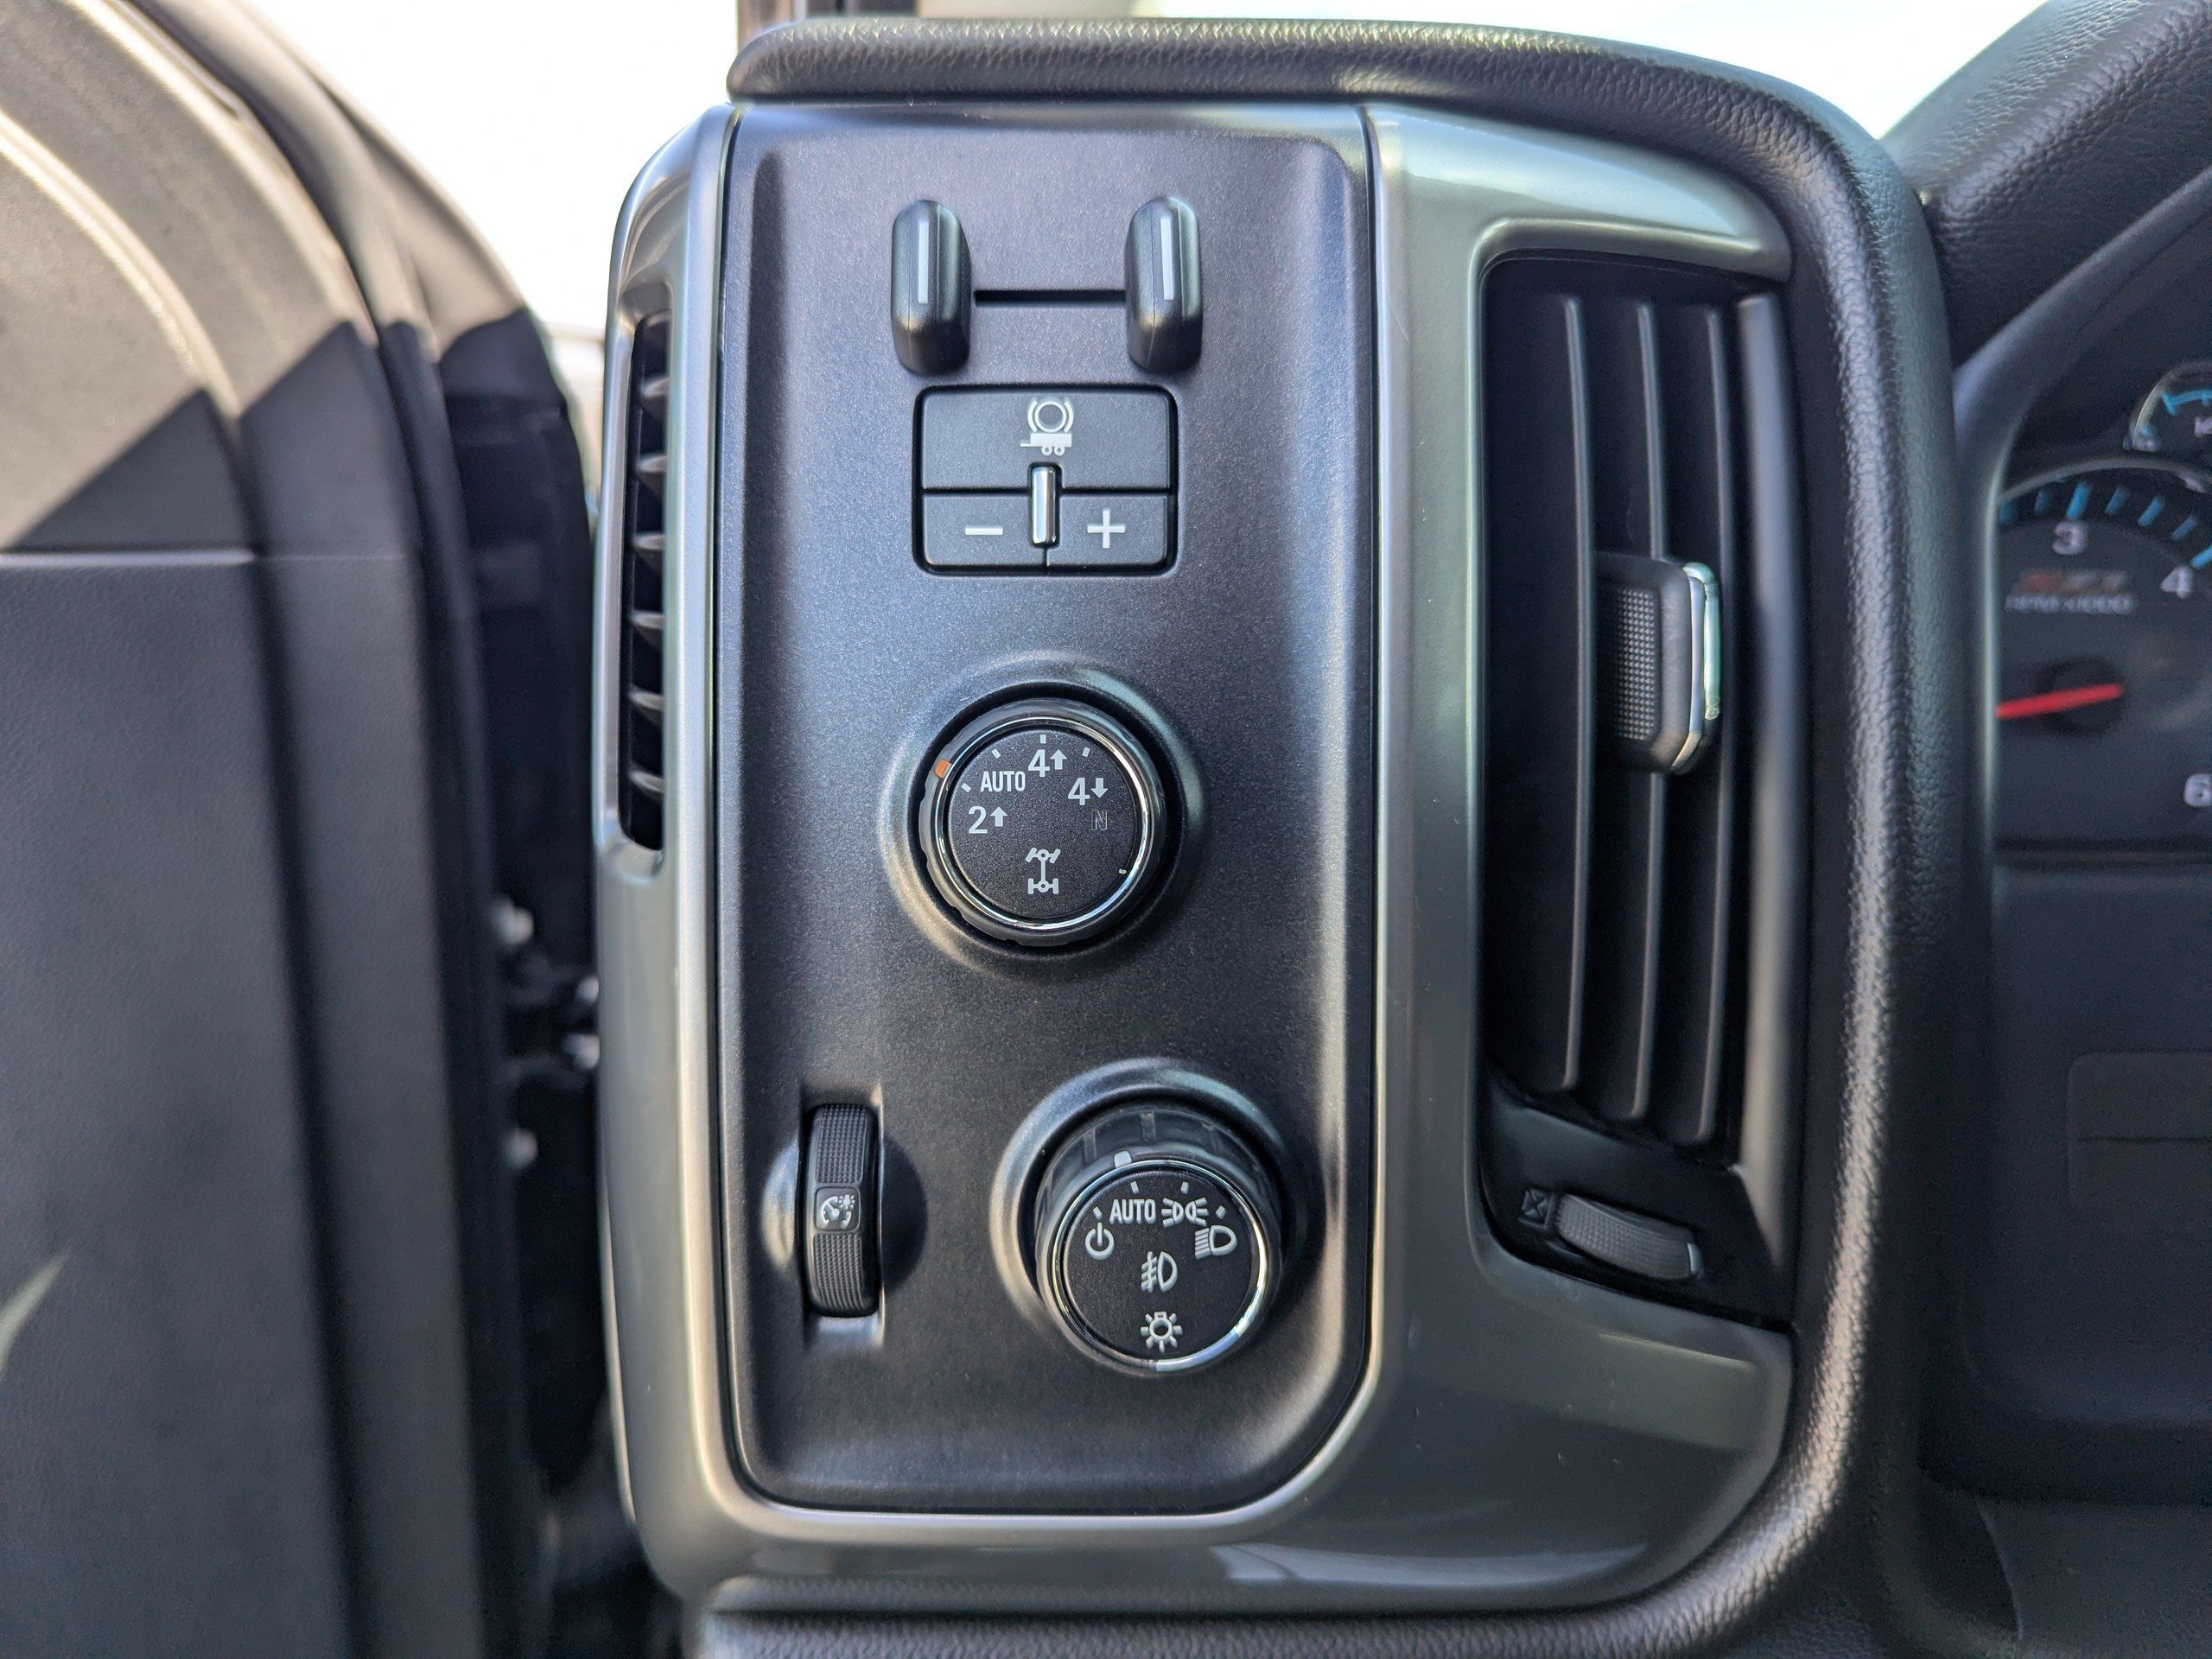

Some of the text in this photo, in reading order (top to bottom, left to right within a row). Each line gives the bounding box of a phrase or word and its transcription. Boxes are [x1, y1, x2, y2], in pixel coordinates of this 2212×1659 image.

[2052, 521, 2088, 555] 3
[2160, 565, 2194, 600] 4
[1027, 749, 1050, 778] 4
[980, 770, 1026, 791] AUTO
[1067, 777, 1090, 806] 4
[2183, 773, 2212, 808] 6
[968, 805, 988, 834] 2
[1109, 1198, 1156, 1224] AUTO
